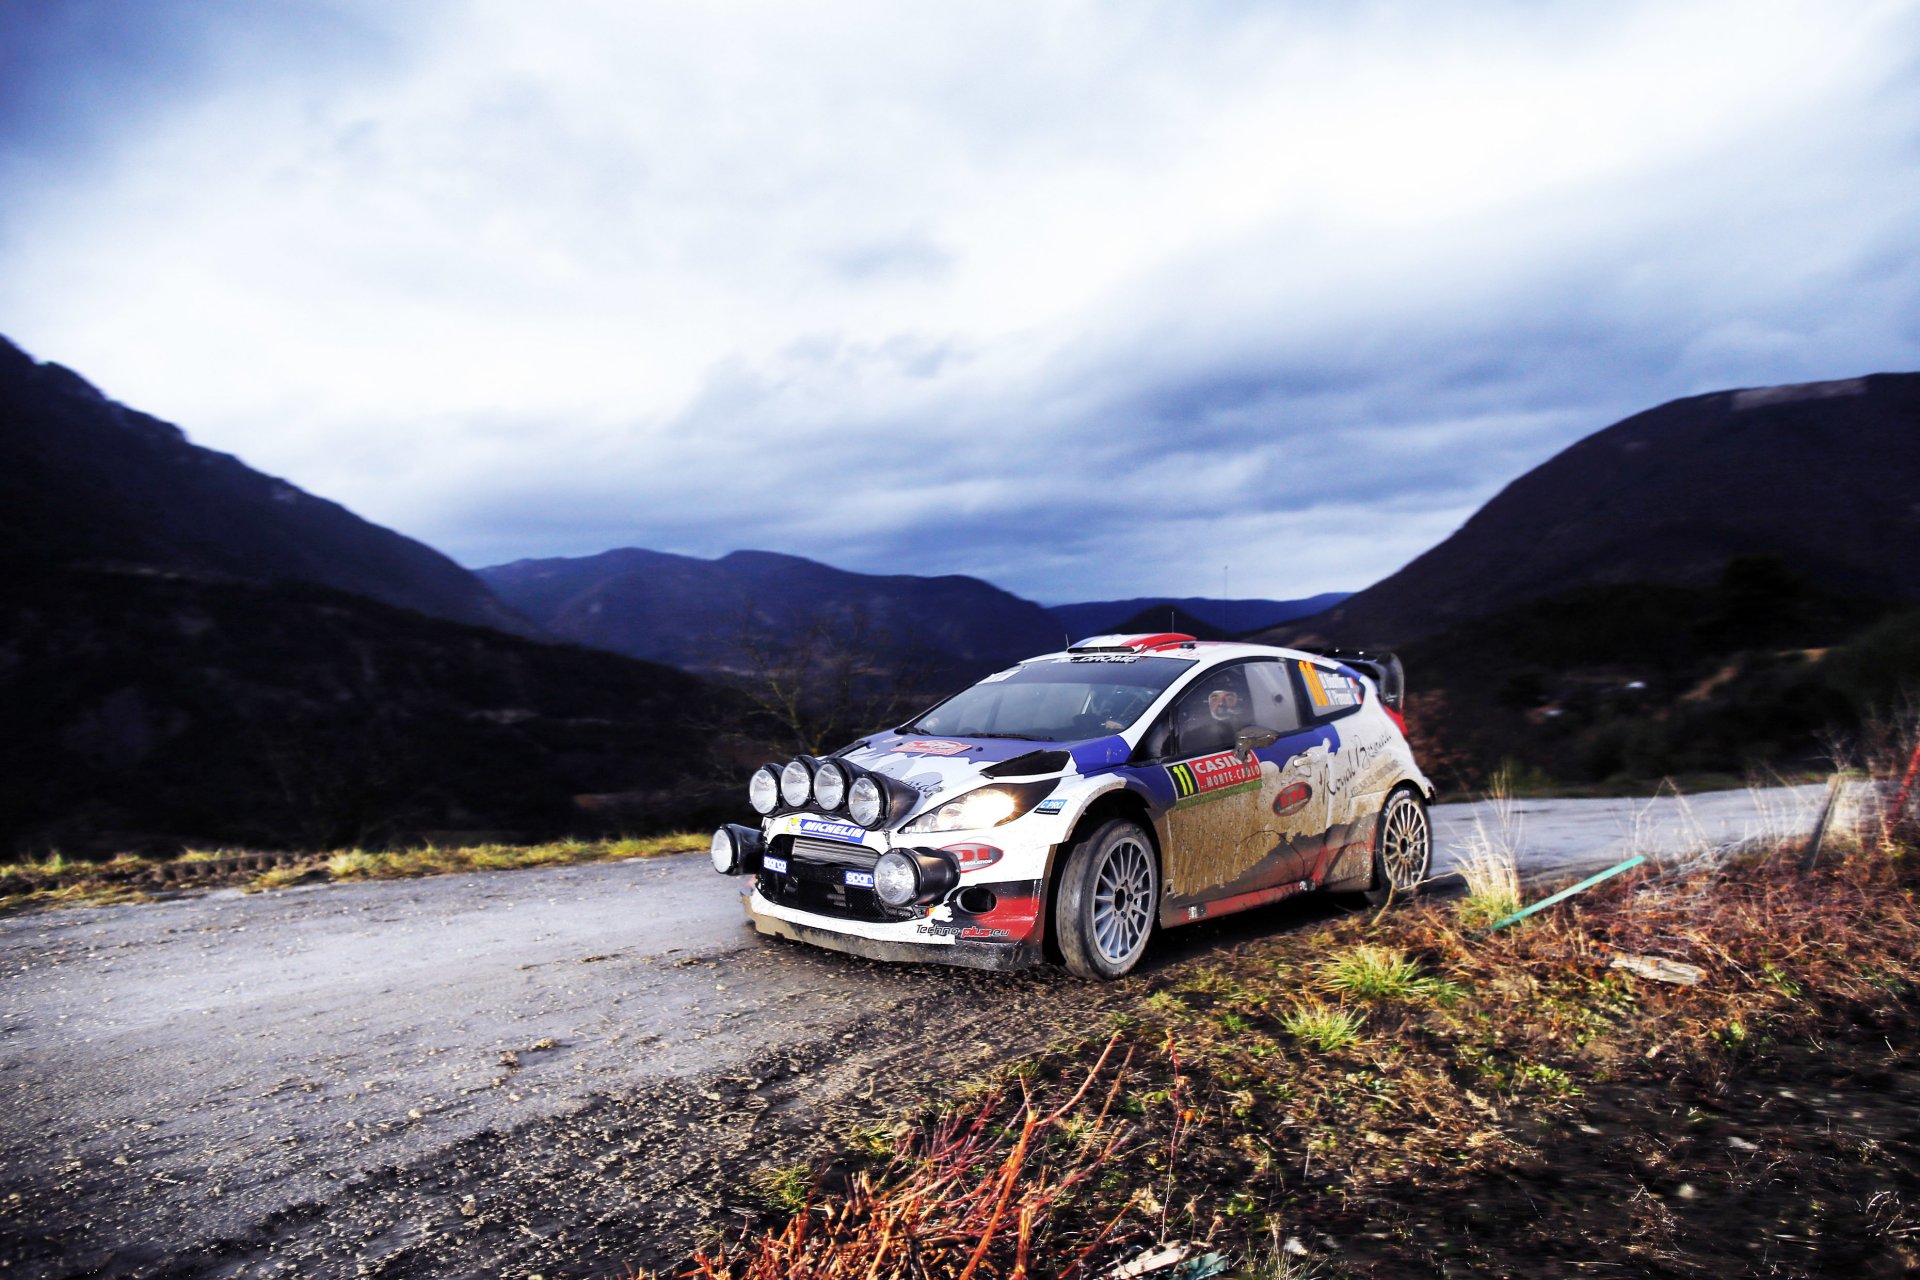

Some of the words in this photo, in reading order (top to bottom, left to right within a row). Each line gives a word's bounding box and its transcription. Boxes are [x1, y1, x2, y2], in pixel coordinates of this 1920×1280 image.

[1298, 661, 1329, 706] 11
[1172, 764, 1194, 796] 11
[802, 821, 866, 838] MICHELIN
[904, 826, 931, 834] PIAA
[845, 872, 874, 884] spar
